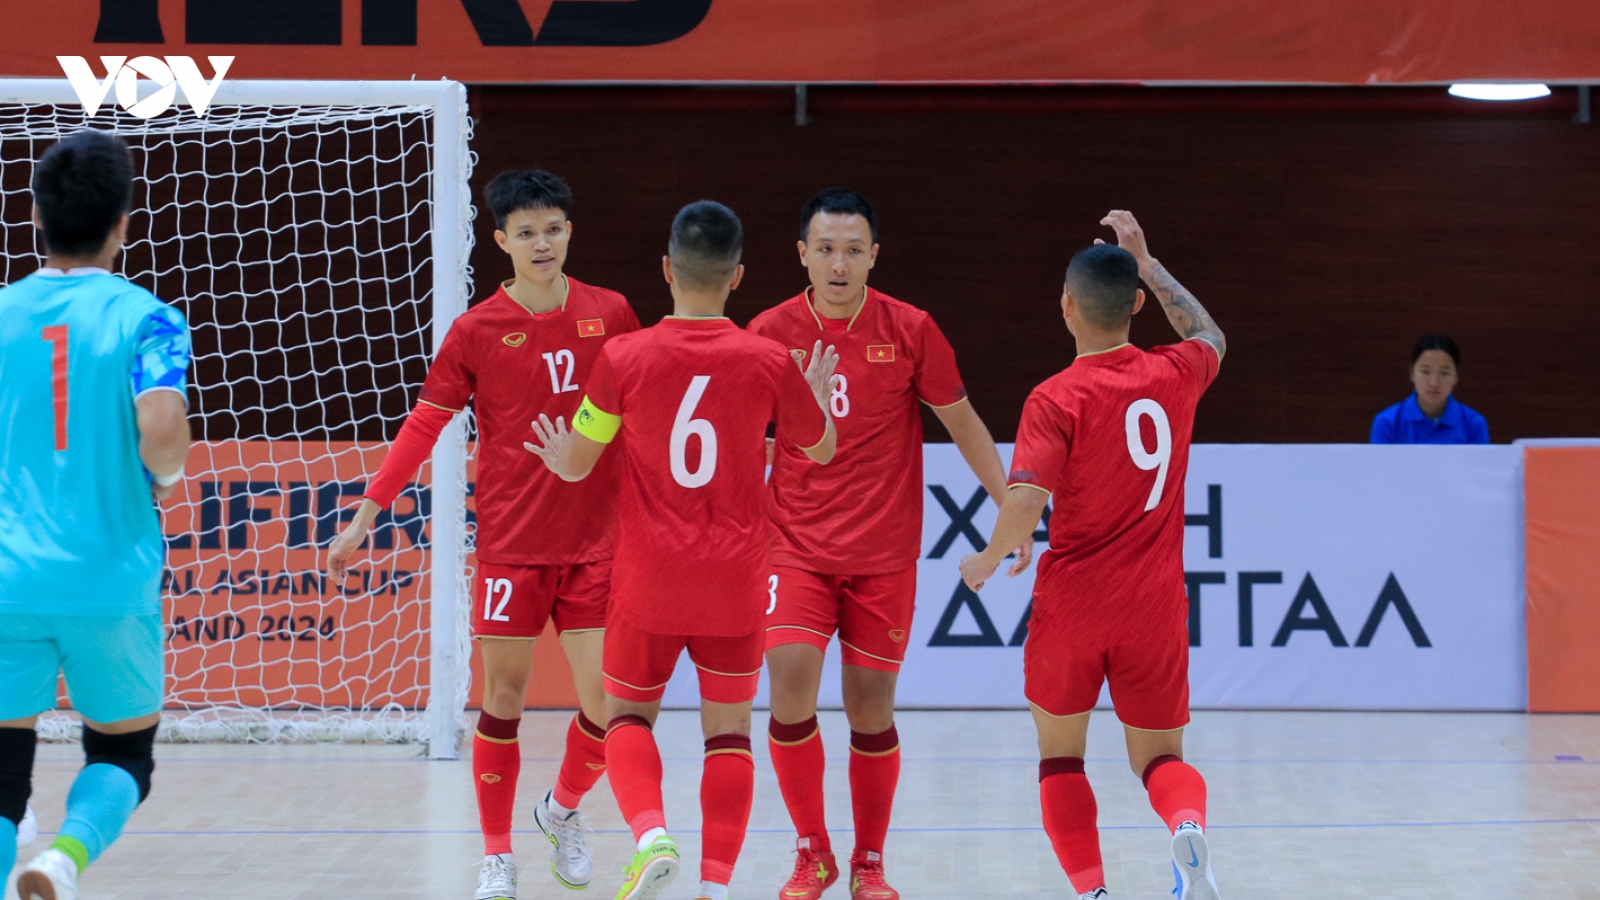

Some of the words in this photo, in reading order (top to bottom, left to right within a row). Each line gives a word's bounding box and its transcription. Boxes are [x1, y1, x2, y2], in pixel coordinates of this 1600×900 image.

[42, 324, 69, 450] 1
[542, 349, 579, 394] 12
[829, 373, 850, 418] 8
[669, 375, 718, 488] 6
[1125, 398, 1172, 512] 9
[158, 482, 475, 549] IFIER
[212, 570, 325, 595] ASIAN
[336, 570, 413, 595] CUP
[483, 577, 513, 623] 12
[257, 616, 335, 641] 2024
